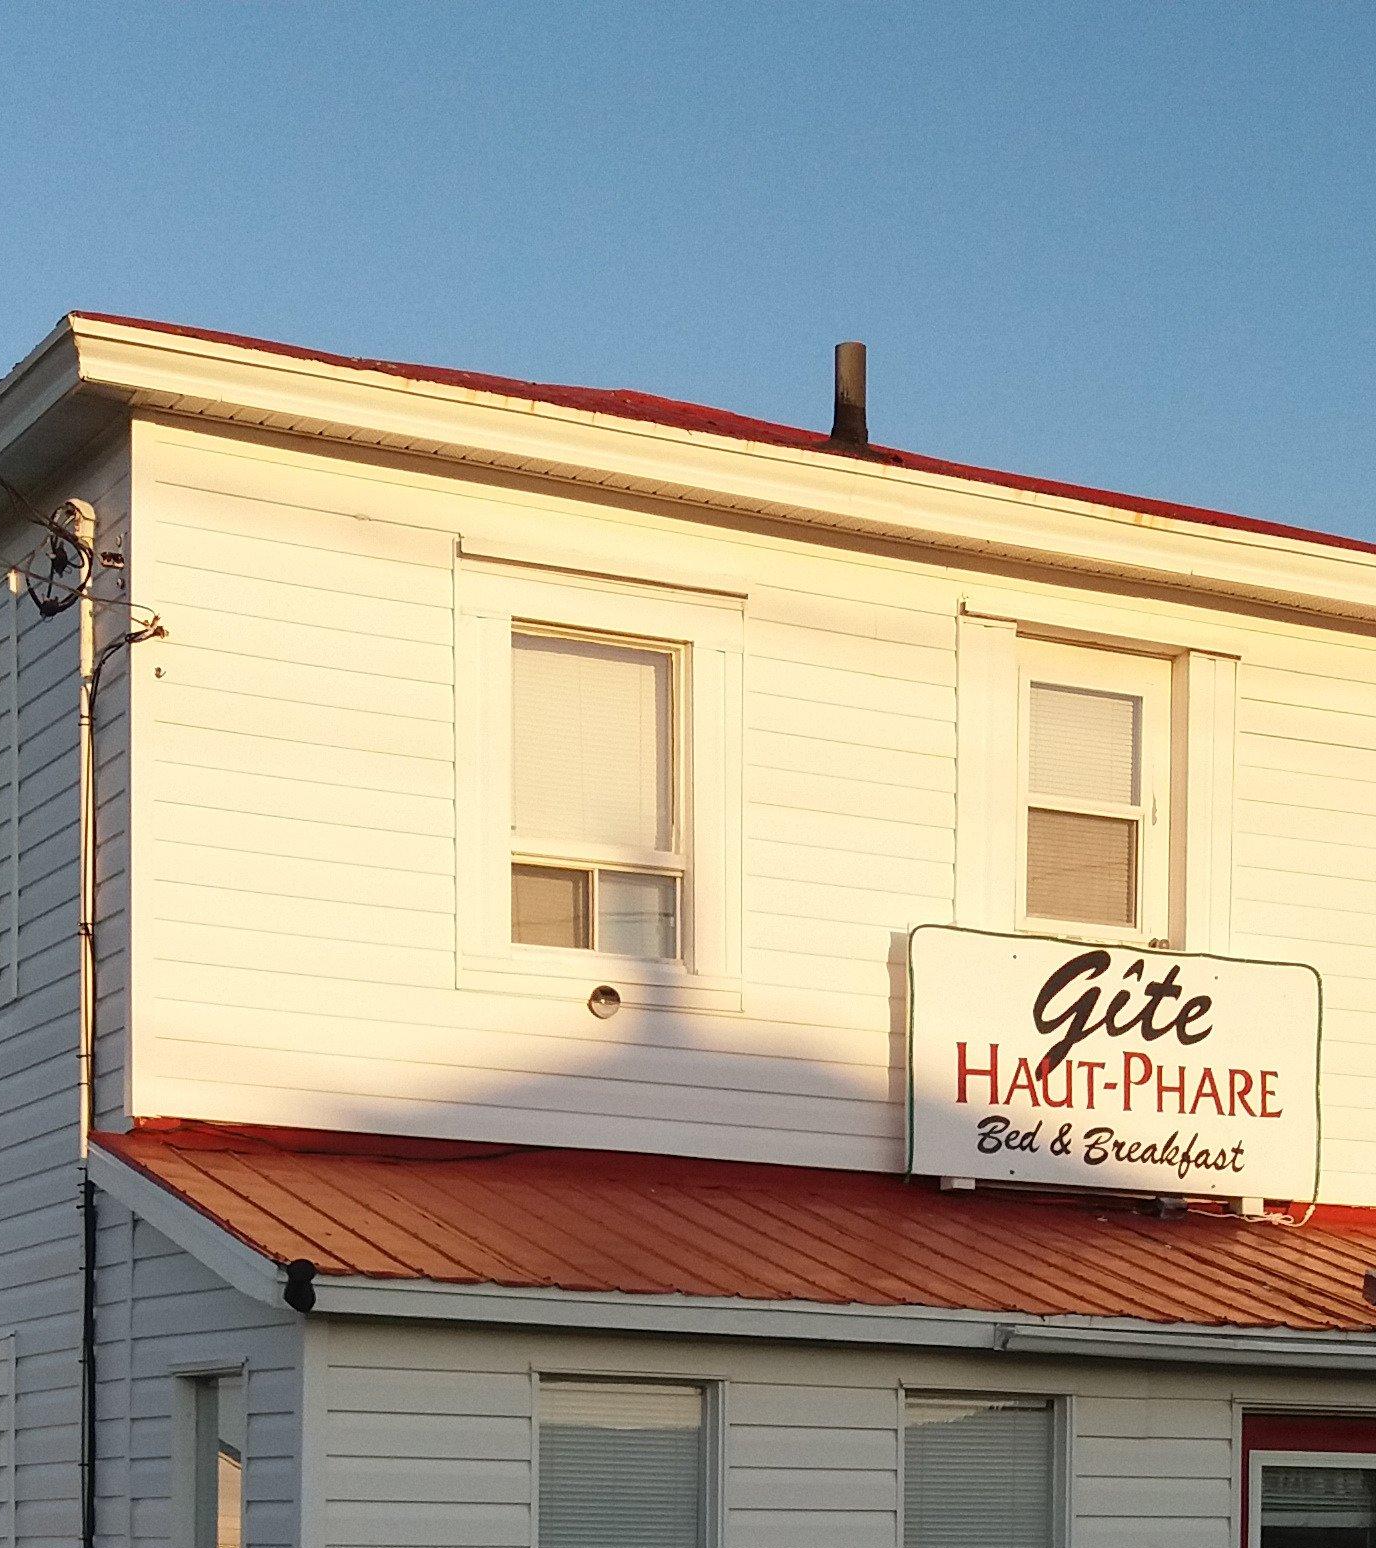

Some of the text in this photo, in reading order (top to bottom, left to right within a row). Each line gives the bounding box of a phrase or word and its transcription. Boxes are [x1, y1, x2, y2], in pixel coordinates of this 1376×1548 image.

[1033, 949, 1213, 1082] Gîte
[955, 1040, 1284, 1120] HAUT-PHARE
[977, 1115, 1245, 1180] Bed & Breakfast
